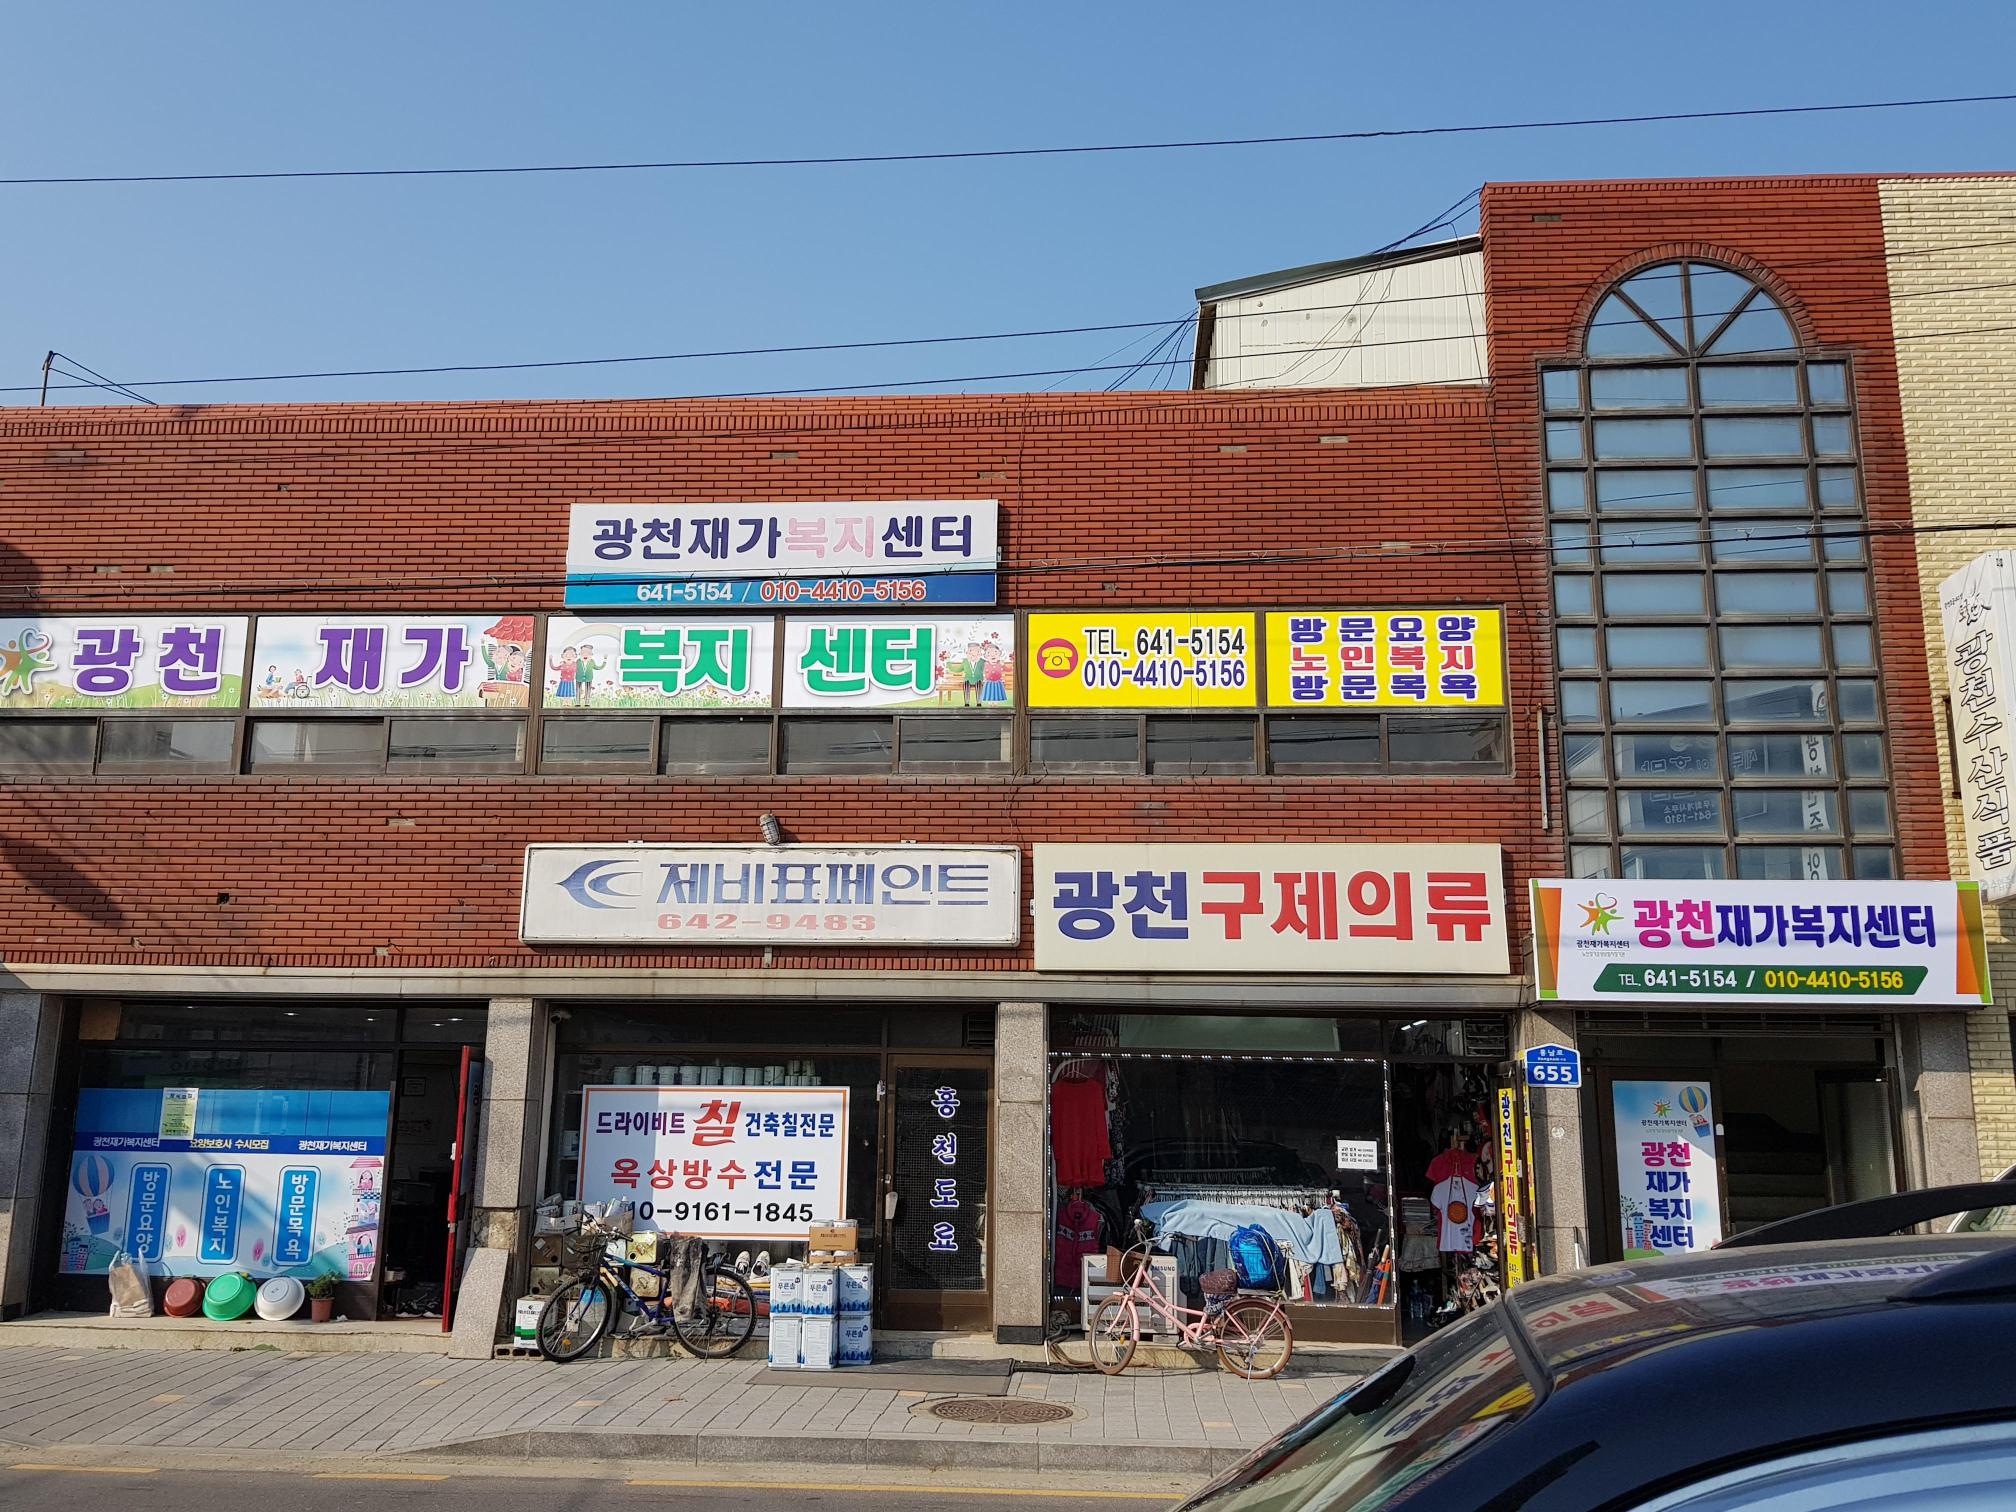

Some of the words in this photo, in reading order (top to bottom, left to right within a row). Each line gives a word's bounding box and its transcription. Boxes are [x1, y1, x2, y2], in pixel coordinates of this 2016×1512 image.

[593, 515, 971, 561] 광천재가복지센터
[637, 580, 734, 602] 641-5154
[761, 579, 927, 602] 010-4410-5156
[1084, 629, 1128, 656] TEL.
[1136, 628, 1245, 656] 641-5154
[72, 626, 222, 692] 광천
[315, 627, 470, 690] 재가
[619, 628, 749, 693] 복지
[800, 626, 934, 693] 센터
[1083, 659, 1245, 687] 010-4410-5156
[656, 862, 989, 906] 제비표페인트
[657, 913, 876, 931] 642-9483
[1634, 899, 1936, 949] 광천재가복지센터
[1576, 939, 1630, 949] 광천재가복지센터
[1618, 973, 1641, 987] TEL.
[1644, 970, 1737, 988] 641-5154
[1764, 970, 1904, 989] 010-4410-5156
[1533, 1065, 1573, 1082] 655
[595, 1111, 686, 1136] 드라이비트
[691, 1099, 742, 1147] 칠
[744, 1111, 836, 1138] 건축칠전문
[93, 1136, 160, 1148] 광천재가복지센터
[189, 1138, 232, 1149] 요양보호사
[234, 1139, 270, 1150] 수시모집
[298, 1140, 368, 1152] 광천재가복지센터
[1641, 1141, 1692, 1168] 광천
[1645, 1170, 1692, 1194] 재가
[135, 1170, 161, 1255] 방문요양
[208, 1172, 234, 1255] 노인복지
[283, 1174, 309, 1260] 방문목욕
[631, 1201, 814, 1223] 10-9161-1845
[1649, 1197, 1692, 1221] 복지
[1650, 1224, 1694, 1250] 센터
